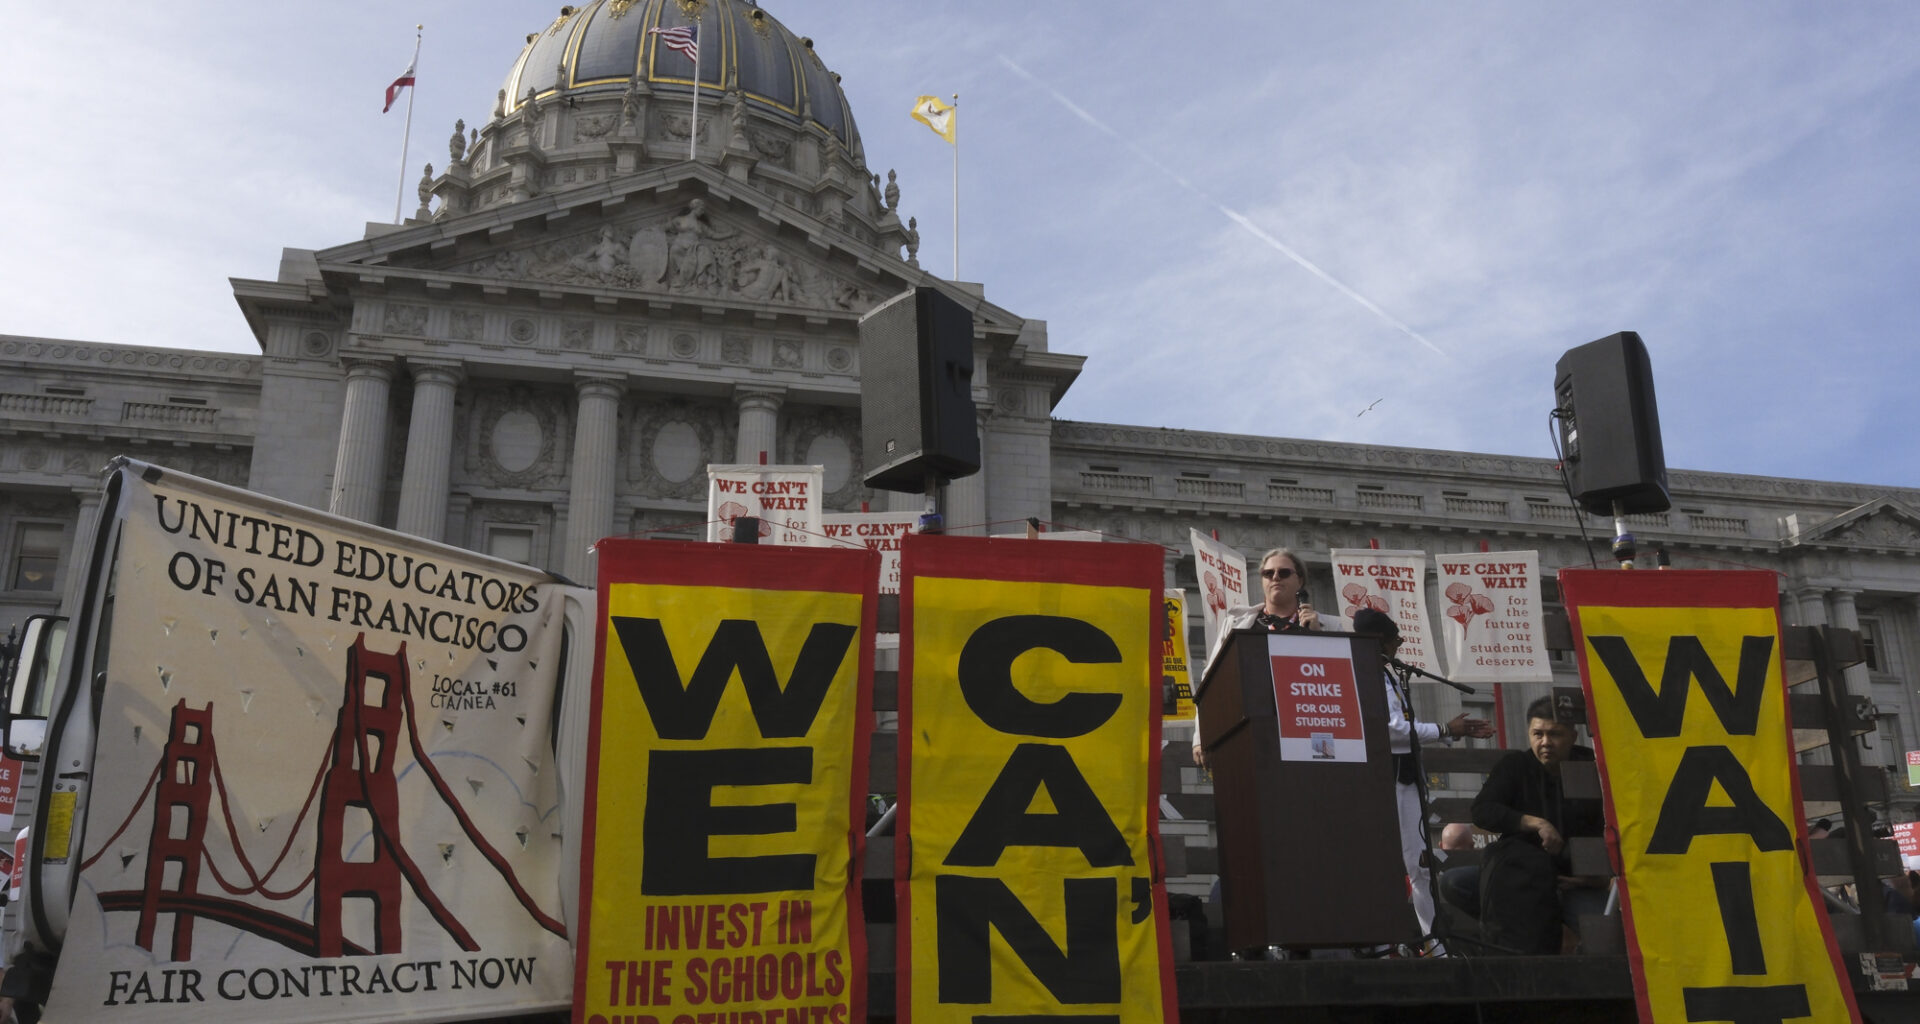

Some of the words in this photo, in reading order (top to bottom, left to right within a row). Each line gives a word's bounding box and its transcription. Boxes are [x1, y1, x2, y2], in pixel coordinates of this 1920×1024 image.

[716, 478, 747, 494] WE
[751, 481, 808, 495] CAN'T
[759, 497, 808, 511] WAIT
[786, 517, 808, 529] for
[822, 524, 852, 538] WE
[856, 522, 912, 537] CAN'T
[783, 532, 807, 543] the
[864, 538, 901, 551] WAI
[154, 493, 324, 568] UNITED
[334, 541, 539, 614] EDUCATORS
[1199, 549, 1215, 567] WE
[1216, 559, 1242, 580] CAN'T
[1338, 564, 1364, 577] WE
[1367, 565, 1414, 579] CAN'T
[1442, 563, 1470, 576] WE
[1474, 563, 1527, 575] CAN'T
[1220, 573, 1242, 594] WAIT
[1375, 578, 1416, 593] WAIT
[1481, 577, 1527, 589] WAIT
[167, 549, 226, 596] OF
[234, 568, 319, 618] SAN
[328, 588, 528, 653] FRANCISCO
[1400, 598, 1417, 609] for
[1508, 595, 1528, 606] for
[1399, 610, 1418, 621] the
[1506, 607, 1528, 617] the
[1485, 619, 1530, 630] future
[1507, 632, 1531, 641] our
[1398, 646, 1424, 656] ents
[1471, 643, 1533, 653] students
[1476, 656, 1534, 667] deserve
[1300, 663, 1325, 677] ON
[432, 674, 488, 696] LOCAL
[492, 681, 517, 697] #61
[1290, 682, 1342, 697] STRIKE
[430, 693, 497, 711] CTA/NEA
[1295, 703, 1317, 713] FOR
[1319, 704, 1342, 714] OUR
[1295, 716, 1346, 728] STUDENTS
[610, 616, 858, 896] WE
[936, 615, 1153, 1024] CAN'
[644, 902, 769, 951] INVEST
[778, 900, 812, 945] IN
[103, 968, 206, 1006] FAIR
[217, 960, 441, 1002] CONTRACT
[451, 956, 537, 988] NOW
[606, 960, 673, 1007] THE
[684, 950, 846, 1006] SCHOOLS
